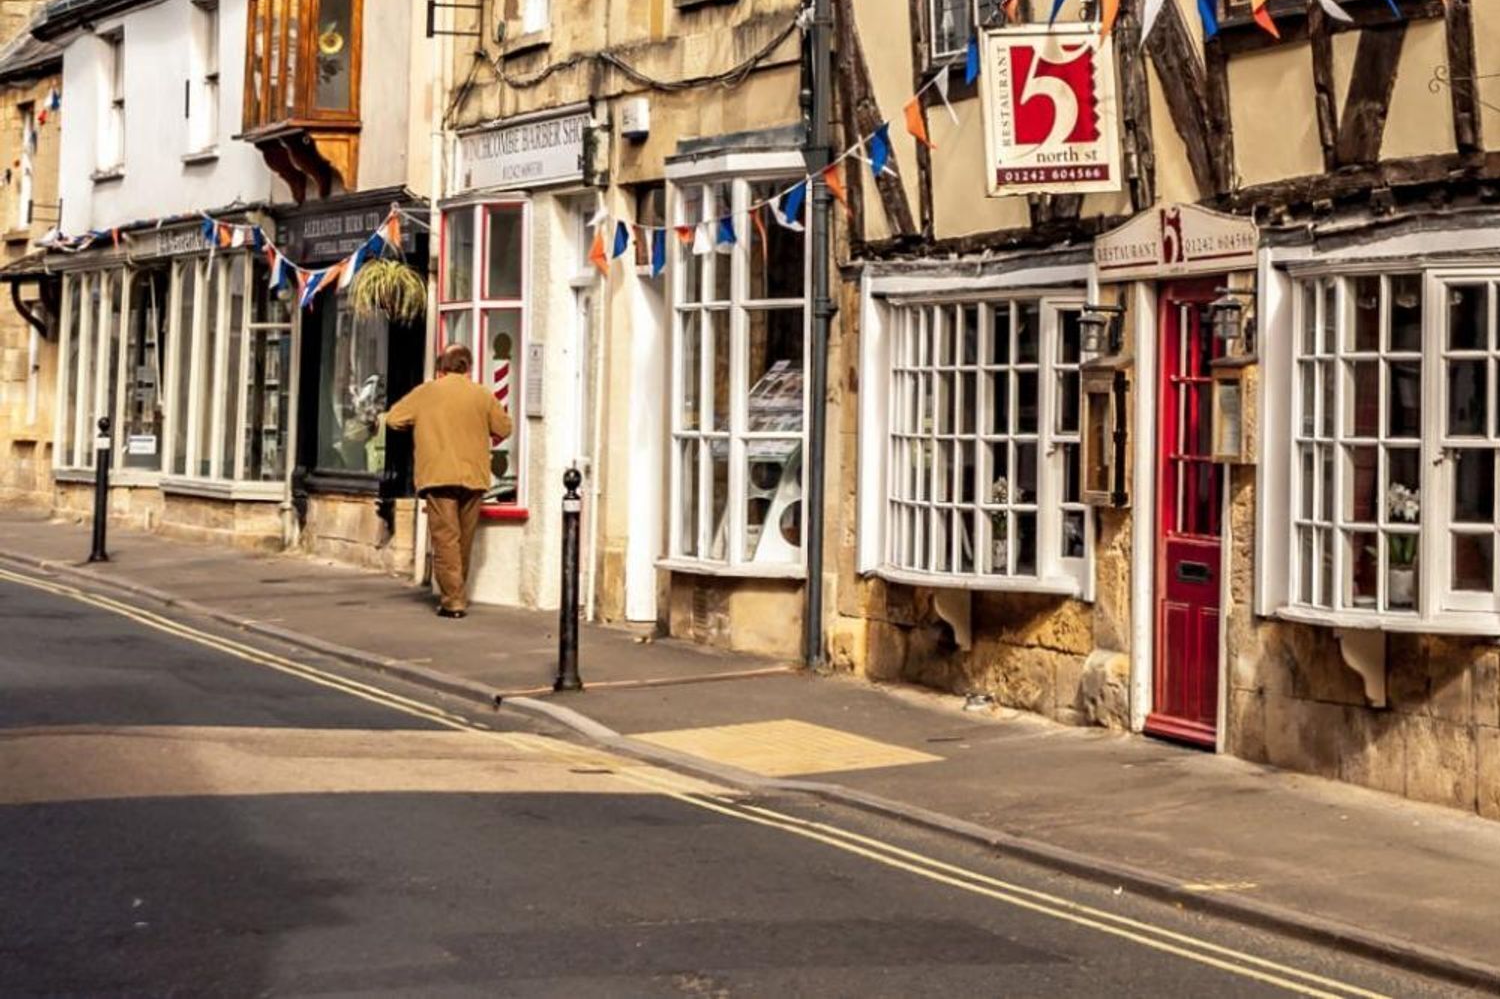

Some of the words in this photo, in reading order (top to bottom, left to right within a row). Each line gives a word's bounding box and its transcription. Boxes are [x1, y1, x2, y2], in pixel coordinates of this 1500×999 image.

[997, 46, 1012, 147] RESTAURANT
[1019, 37, 1093, 154] 5
[521, 121, 562, 153] BARBER
[1036, 147, 1080, 164] north
[1084, 150, 1099, 162] st
[1004, 168, 1047, 182] 01242
[1051, 166, 1102, 180] 604566
[1096, 242, 1158, 262] RESTAURANT
[1185, 236, 1214, 253] 01242
